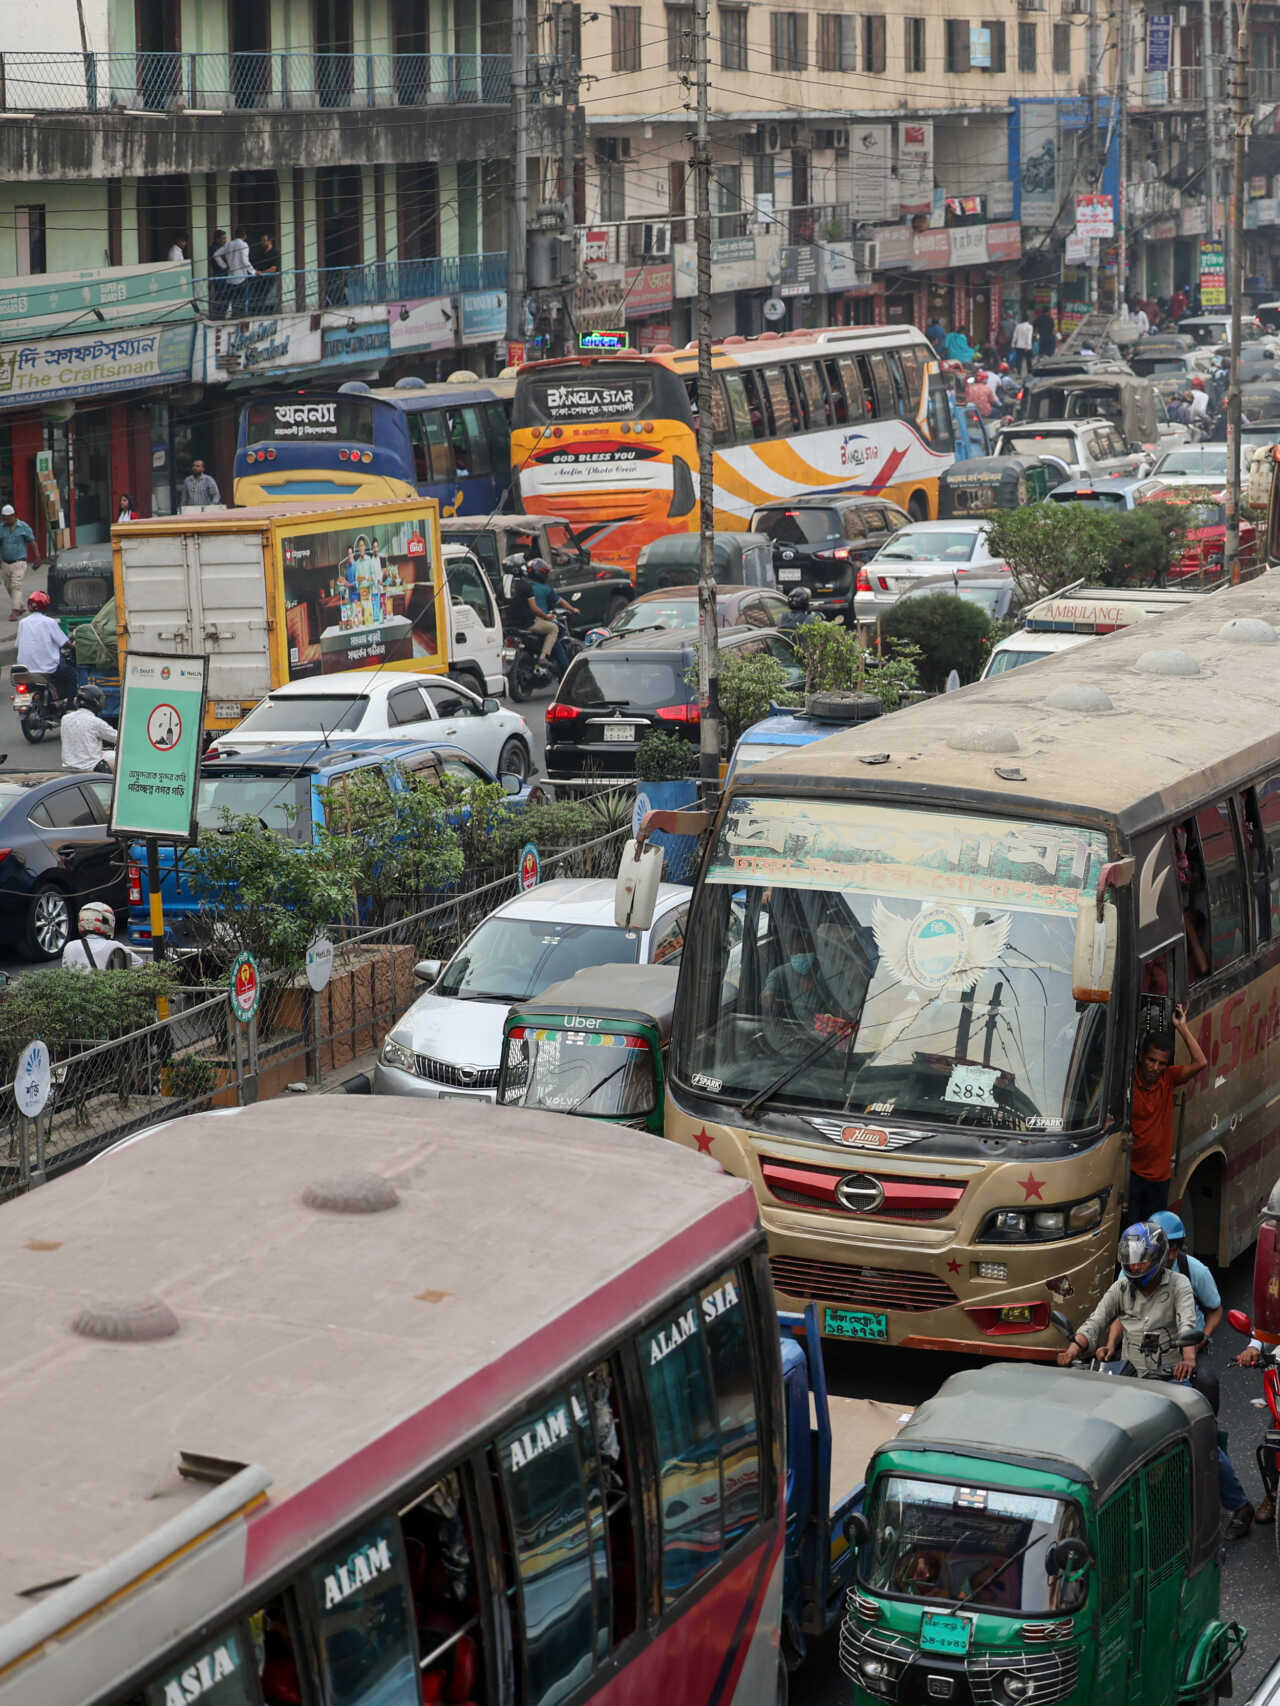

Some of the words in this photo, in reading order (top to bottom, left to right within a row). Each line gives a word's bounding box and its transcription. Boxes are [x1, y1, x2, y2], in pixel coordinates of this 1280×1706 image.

[18, 347, 39, 370] দি
[17, 373, 53, 390] The
[58, 359, 154, 385] Craftsman
[547, 386, 601, 408] BANGLA
[603, 389, 634, 403] STAR
[274, 403, 337, 424] অনন্যা
[552, 455, 576, 464] GOD
[579, 452, 611, 462] BLESS
[614, 450, 637, 461] YOU
[1044, 601, 1125, 622] AMBULANCE
[563, 1015, 603, 1029] Uber
[700, 1076, 721, 1090] SPARK
[1036, 1118, 1062, 1128] SPARK
[856, 1129, 881, 1146] Hino
[650, 1309, 698, 1366] ALAM
[510, 1408, 569, 1472] ALAM
[324, 1539, 392, 1610] ALAM
[164, 1645, 236, 1706] ASIA
